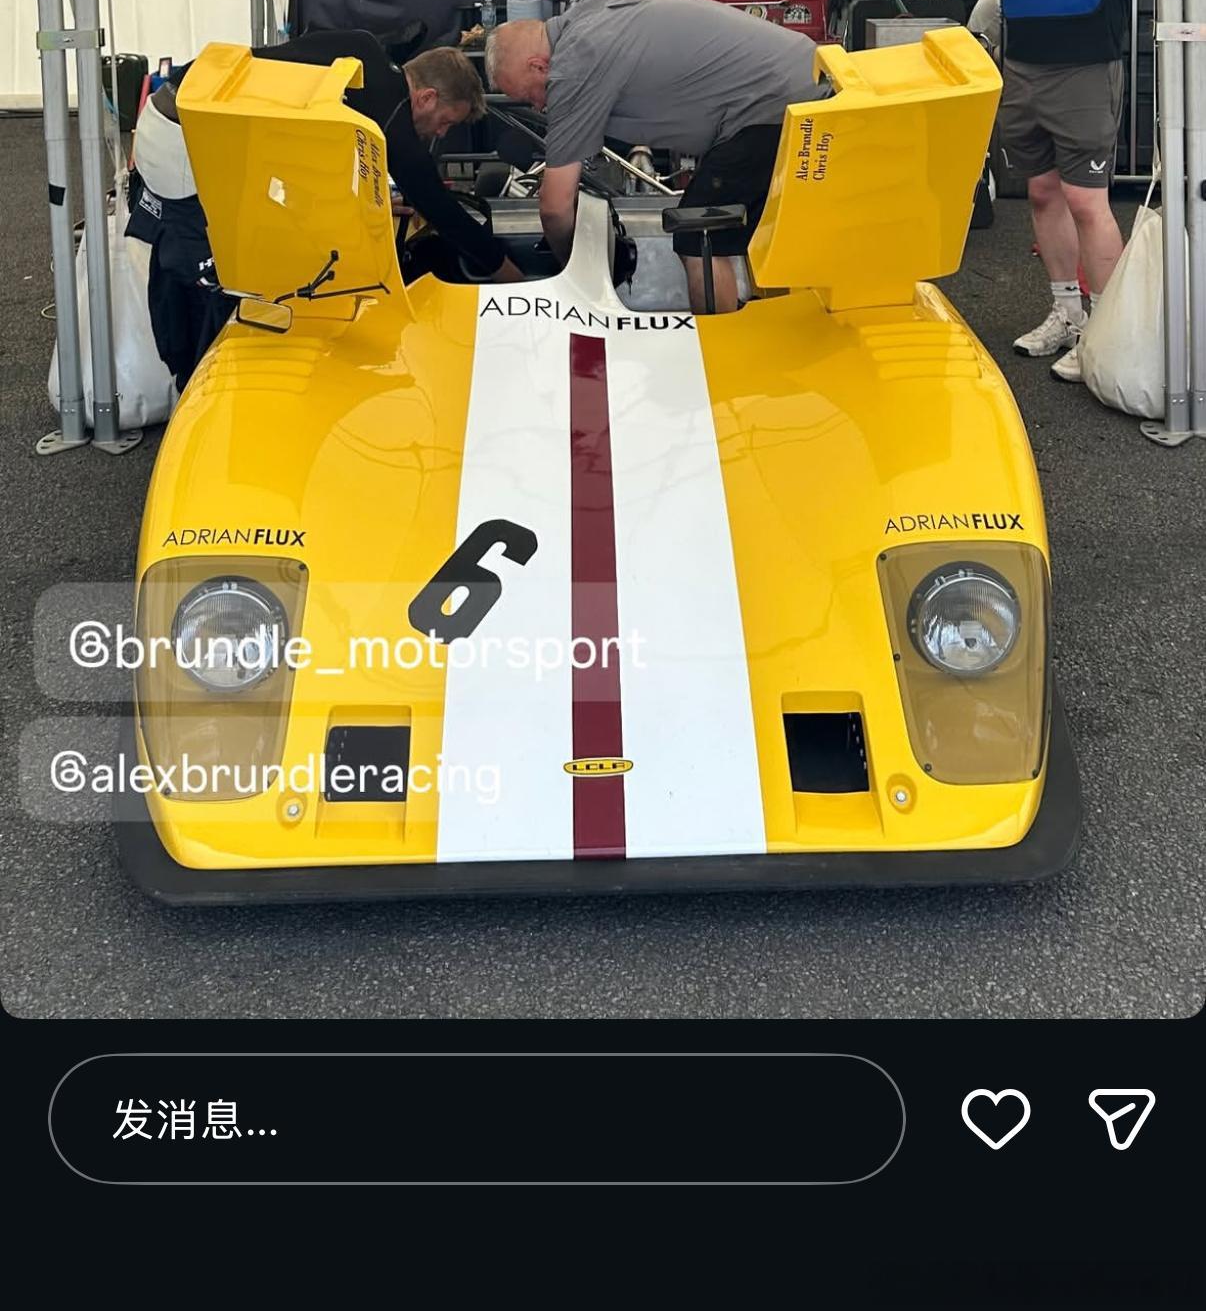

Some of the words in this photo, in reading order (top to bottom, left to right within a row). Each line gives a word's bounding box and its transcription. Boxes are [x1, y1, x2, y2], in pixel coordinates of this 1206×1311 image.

[798, 117, 813, 157] Brundle
[816, 132, 834, 151] Hoy
[795, 160, 809, 180] Alex
[813, 154, 827, 180] Chris
[407, 519, 538, 646] 6
